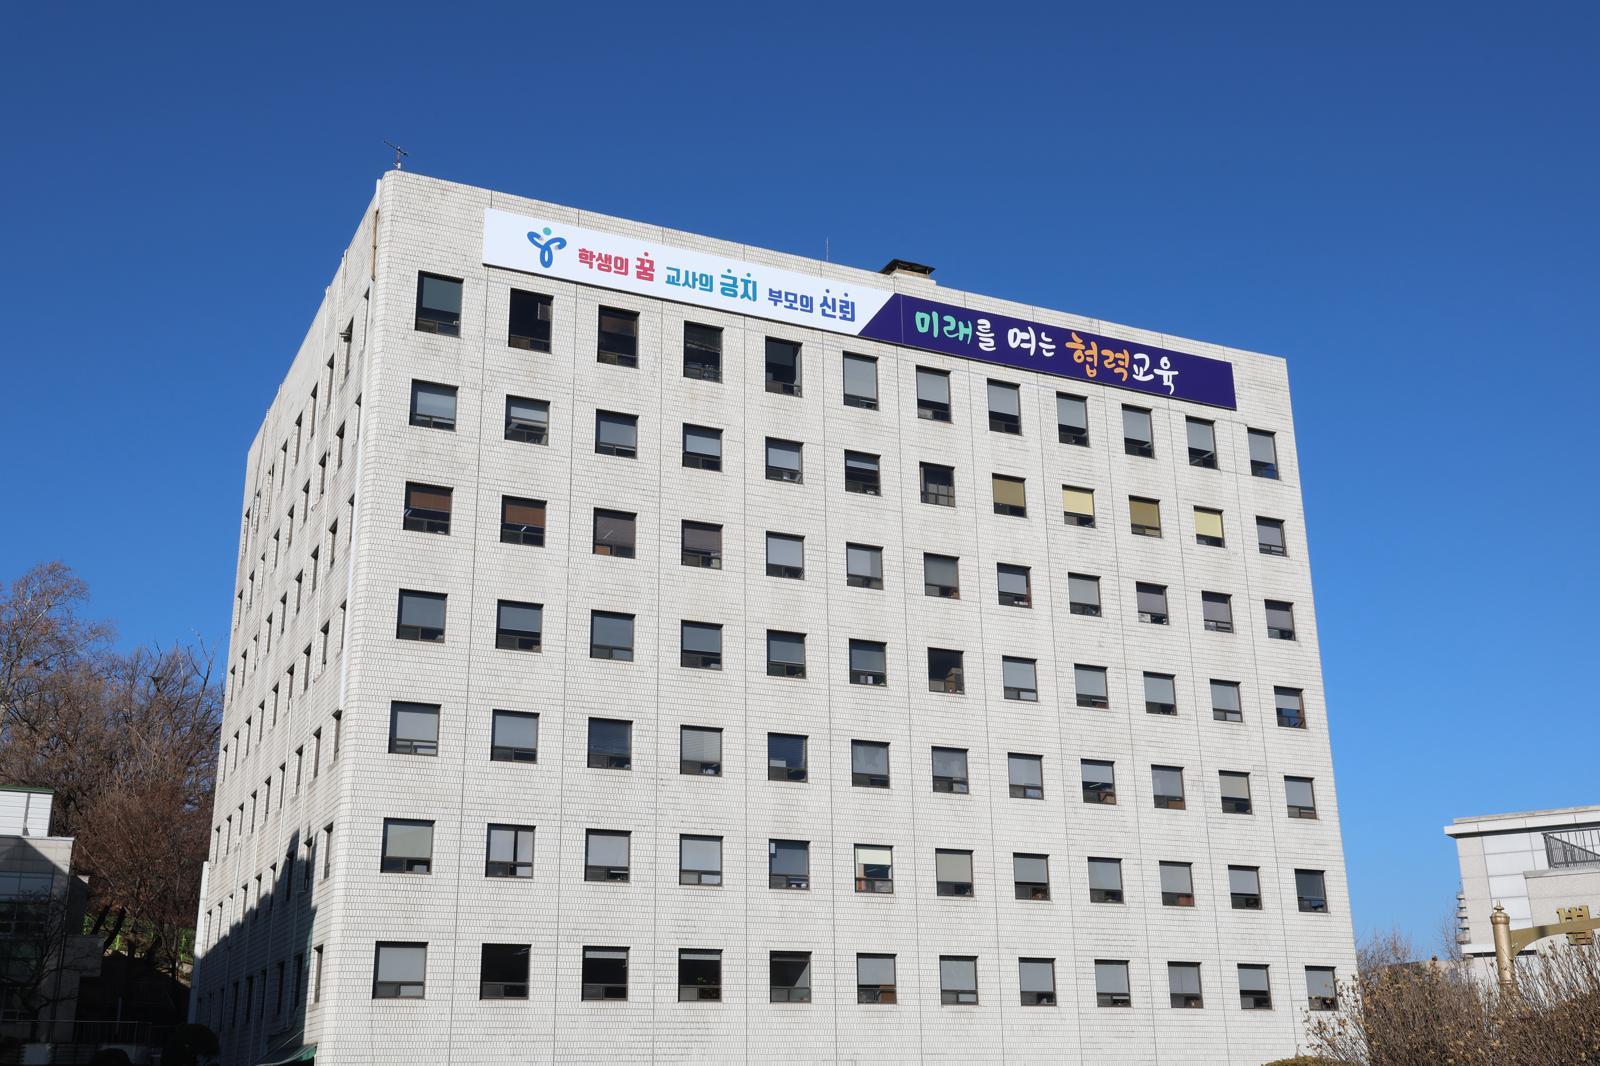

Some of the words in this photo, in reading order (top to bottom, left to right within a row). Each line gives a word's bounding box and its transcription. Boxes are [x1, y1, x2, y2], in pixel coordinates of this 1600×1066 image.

[578, 248, 629, 276] 학생의
[635, 252, 656, 281] 꿈
[665, 266, 714, 292] 교사의
[719, 269, 757, 302] 긍지
[768, 288, 814, 314] 부모의
[819, 289, 856, 322] 신뢰
[915, 311, 997, 352] 미래를
[1008, 326, 1057, 358] 여는
